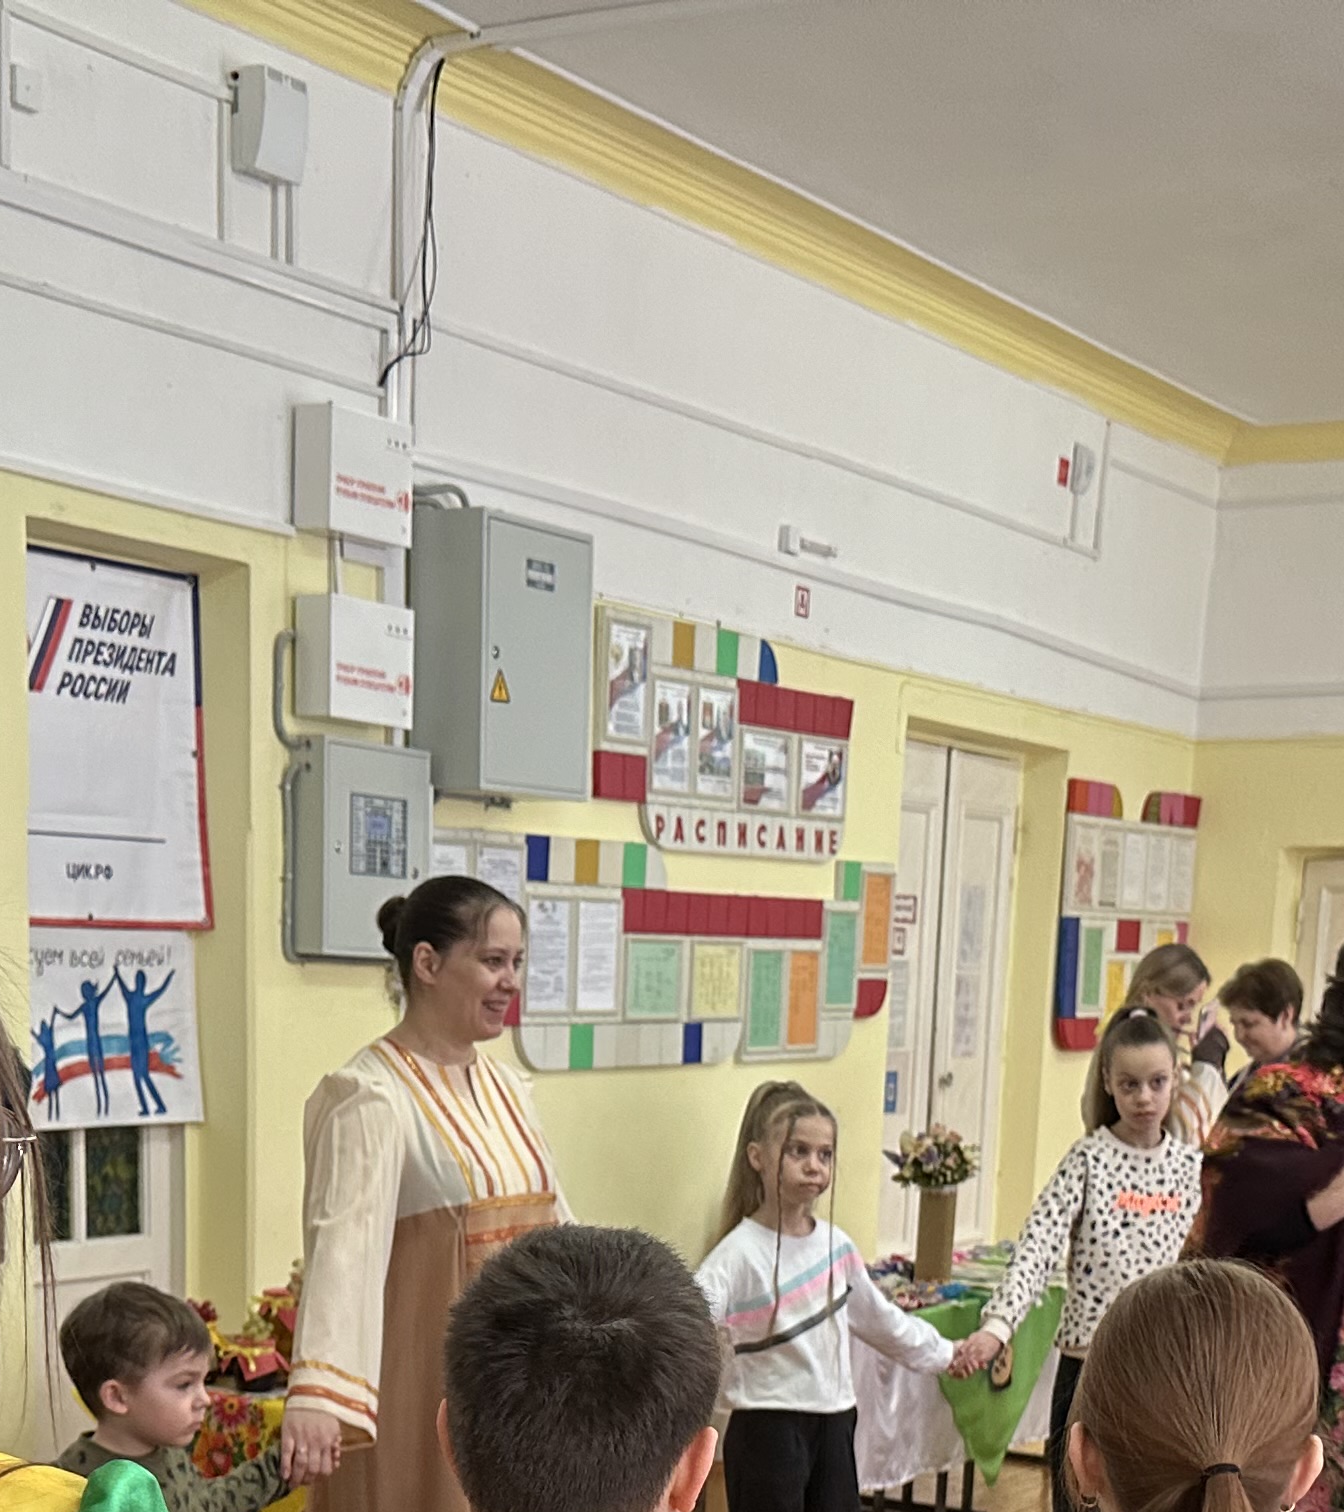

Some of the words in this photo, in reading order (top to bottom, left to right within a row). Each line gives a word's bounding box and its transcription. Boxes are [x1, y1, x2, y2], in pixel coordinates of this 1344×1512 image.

[78, 603, 156, 639] ВЫБОРЫ
[67, 637, 177, 677] ПРЕЗИДЕНТА
[56, 671, 132, 704] РОССИИ
[654, 815, 837, 855] РАСПИСАНИЕ
